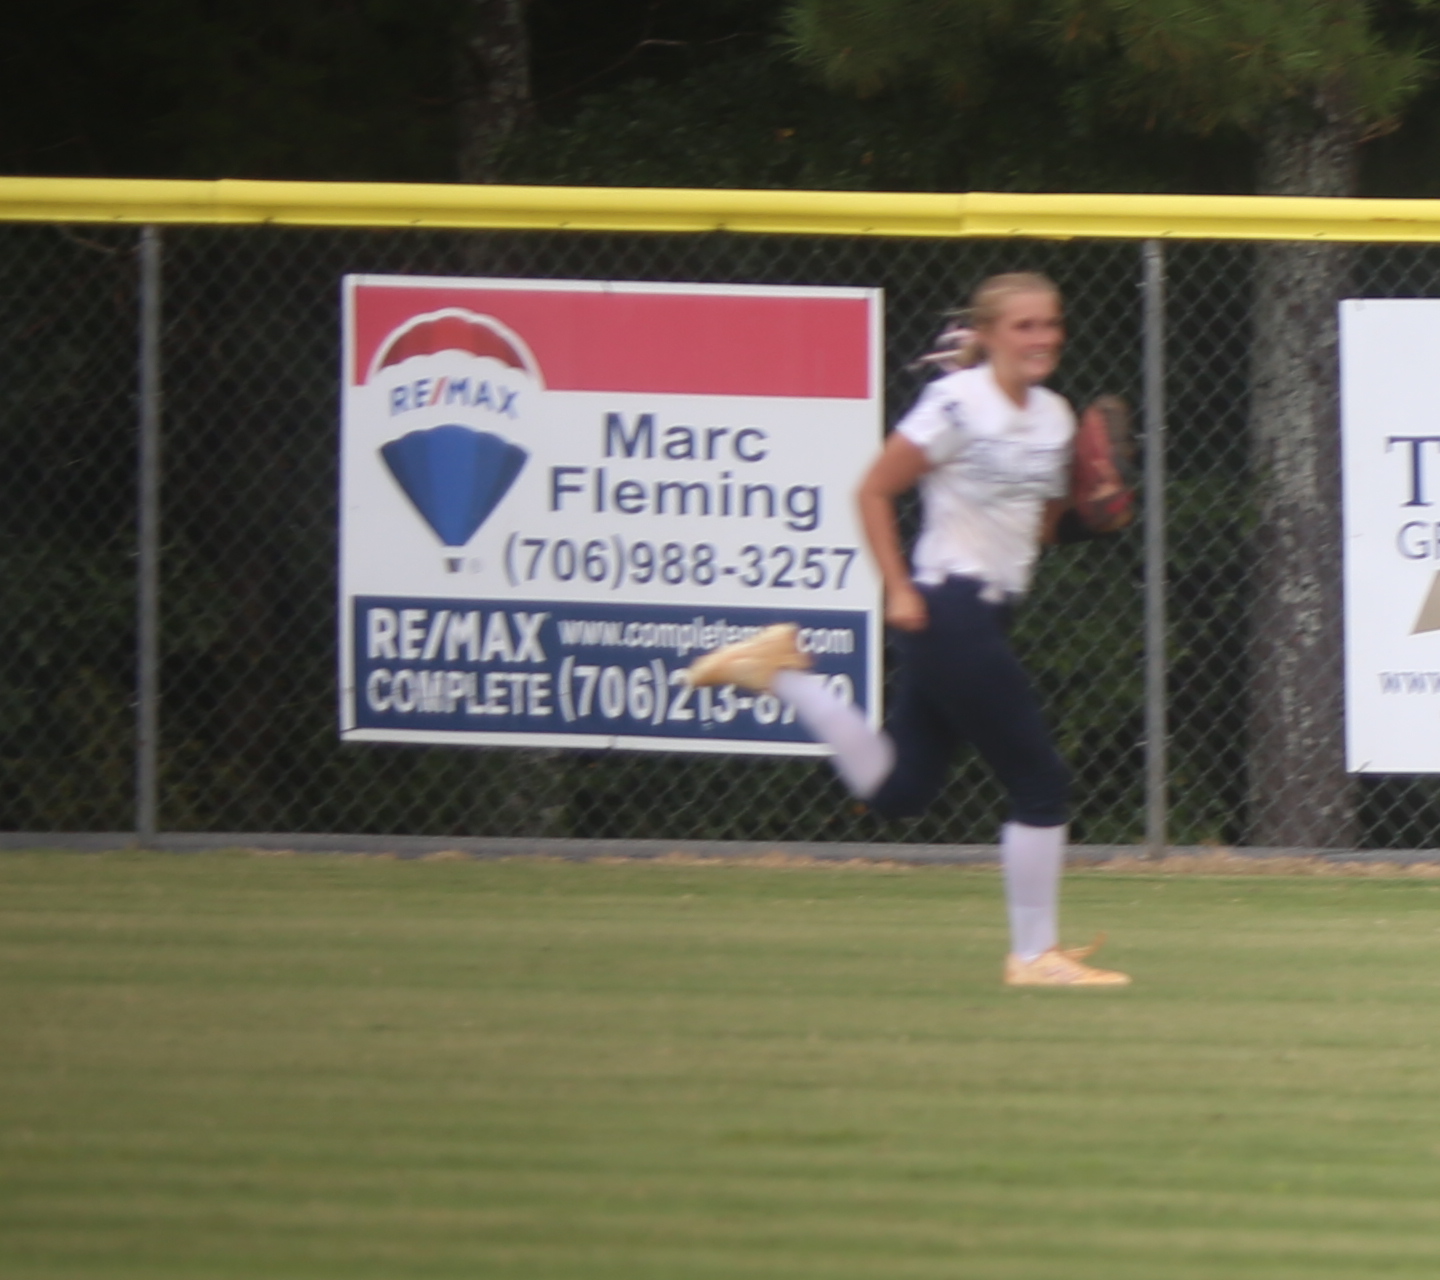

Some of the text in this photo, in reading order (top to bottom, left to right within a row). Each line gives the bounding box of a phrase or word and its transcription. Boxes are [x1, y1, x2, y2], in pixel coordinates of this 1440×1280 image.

[389, 375, 519, 420] RE/MAX
[602, 411, 770, 465] Marc
[548, 466, 823, 532] Fleming
[503, 531, 858, 590] (706)988-3257
[367, 608, 550, 663] RE/MAX
[366, 668, 552, 717] COMPLETE
